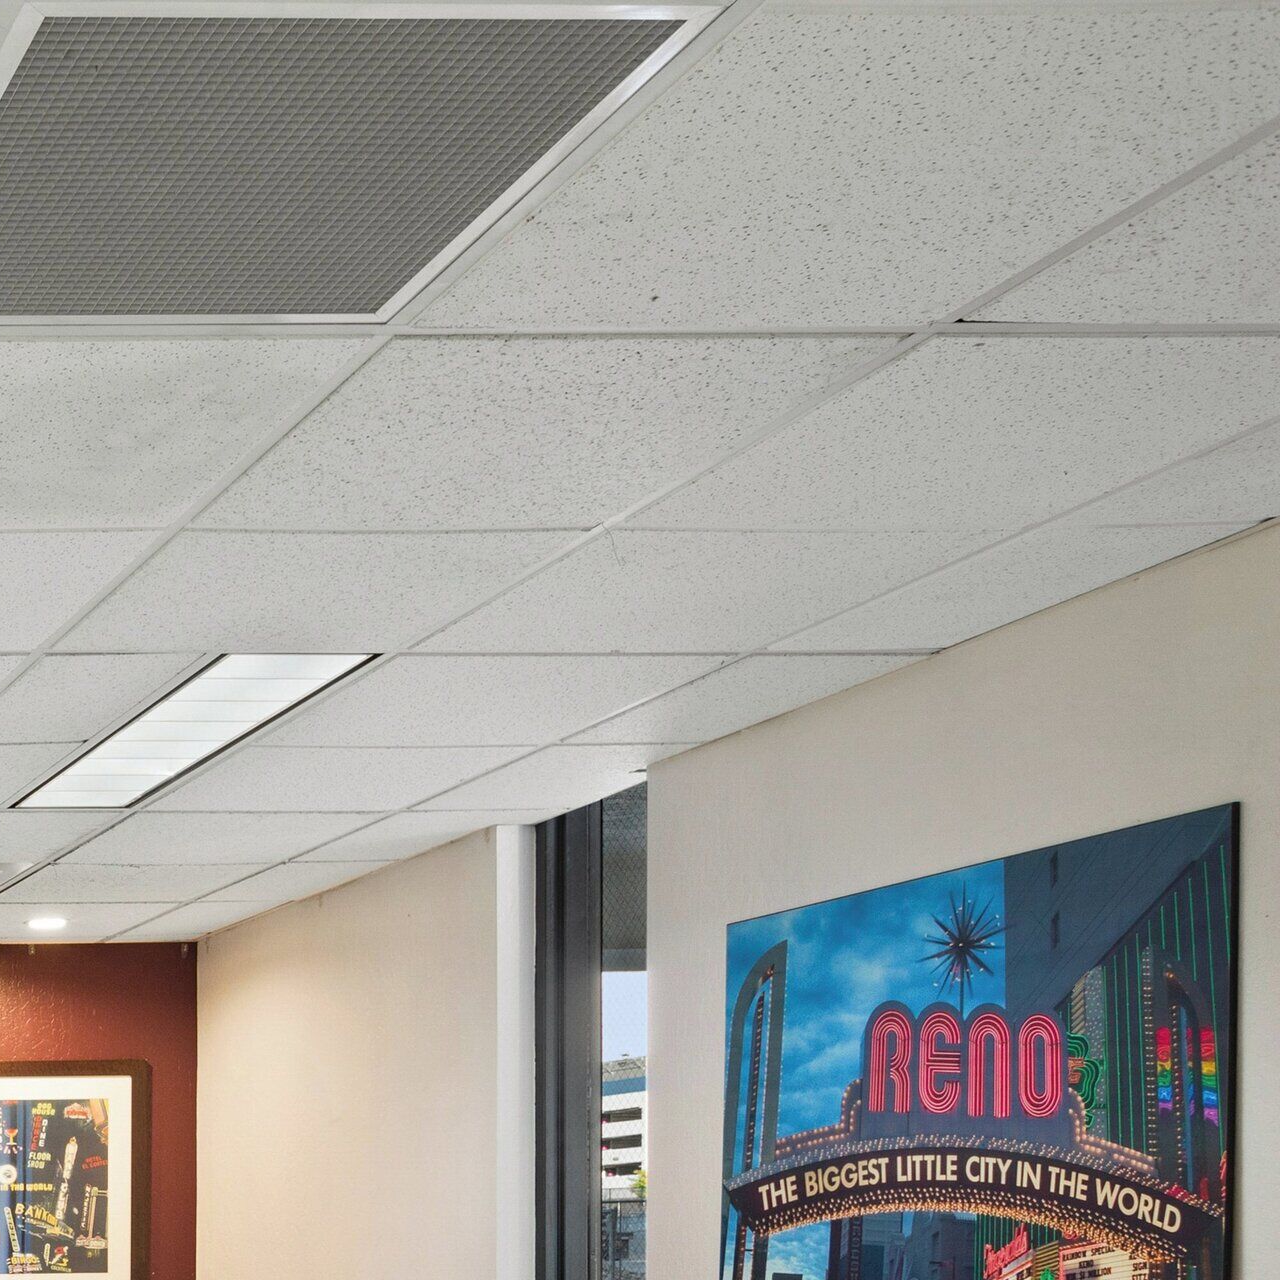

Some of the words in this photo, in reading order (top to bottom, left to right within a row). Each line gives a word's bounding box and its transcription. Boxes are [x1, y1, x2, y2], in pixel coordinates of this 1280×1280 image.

[868, 1010, 1062, 1118] RENO
[29, 1152, 52, 1161] FLOOR
[758, 1175, 798, 1211] THE
[804, 1157, 889, 1197] BIGGEST
[896, 1154, 958, 1182] LITTLE
[965, 1155, 1012, 1185] CITY
[1016, 1160, 1041, 1190] IN
[1048, 1166, 1089, 1201] THE
[1095, 1177, 1181, 1233] WORLD
